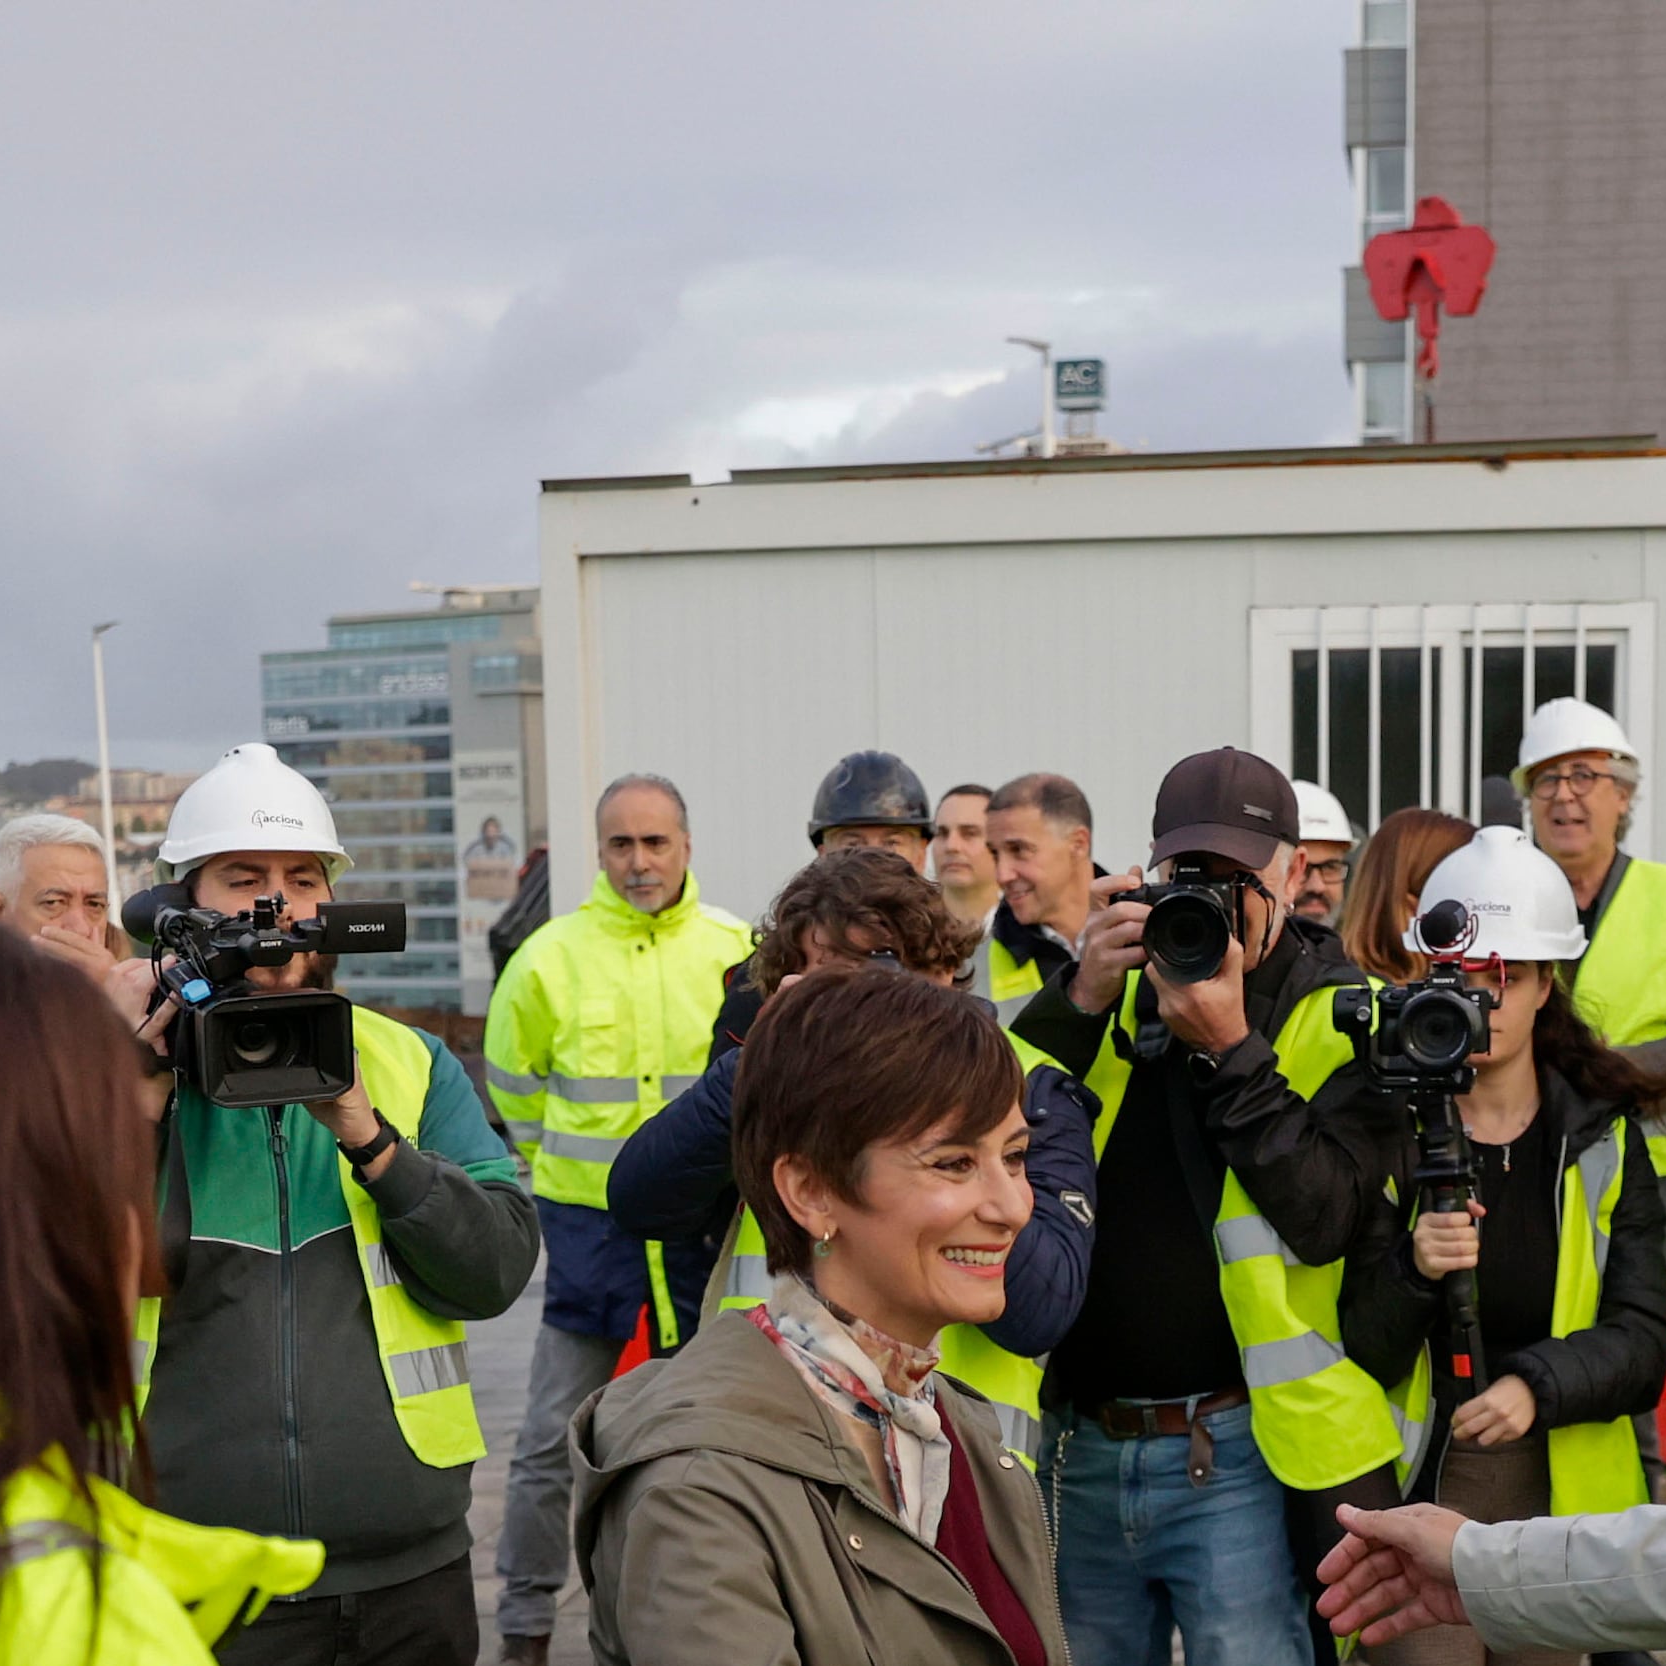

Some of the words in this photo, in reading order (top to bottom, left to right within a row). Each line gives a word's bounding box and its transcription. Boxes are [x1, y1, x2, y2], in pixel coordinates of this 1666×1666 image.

[262, 814, 304, 827] acciona
[1471, 901, 1511, 913] acciona
[259, 940, 282, 948] SONY
